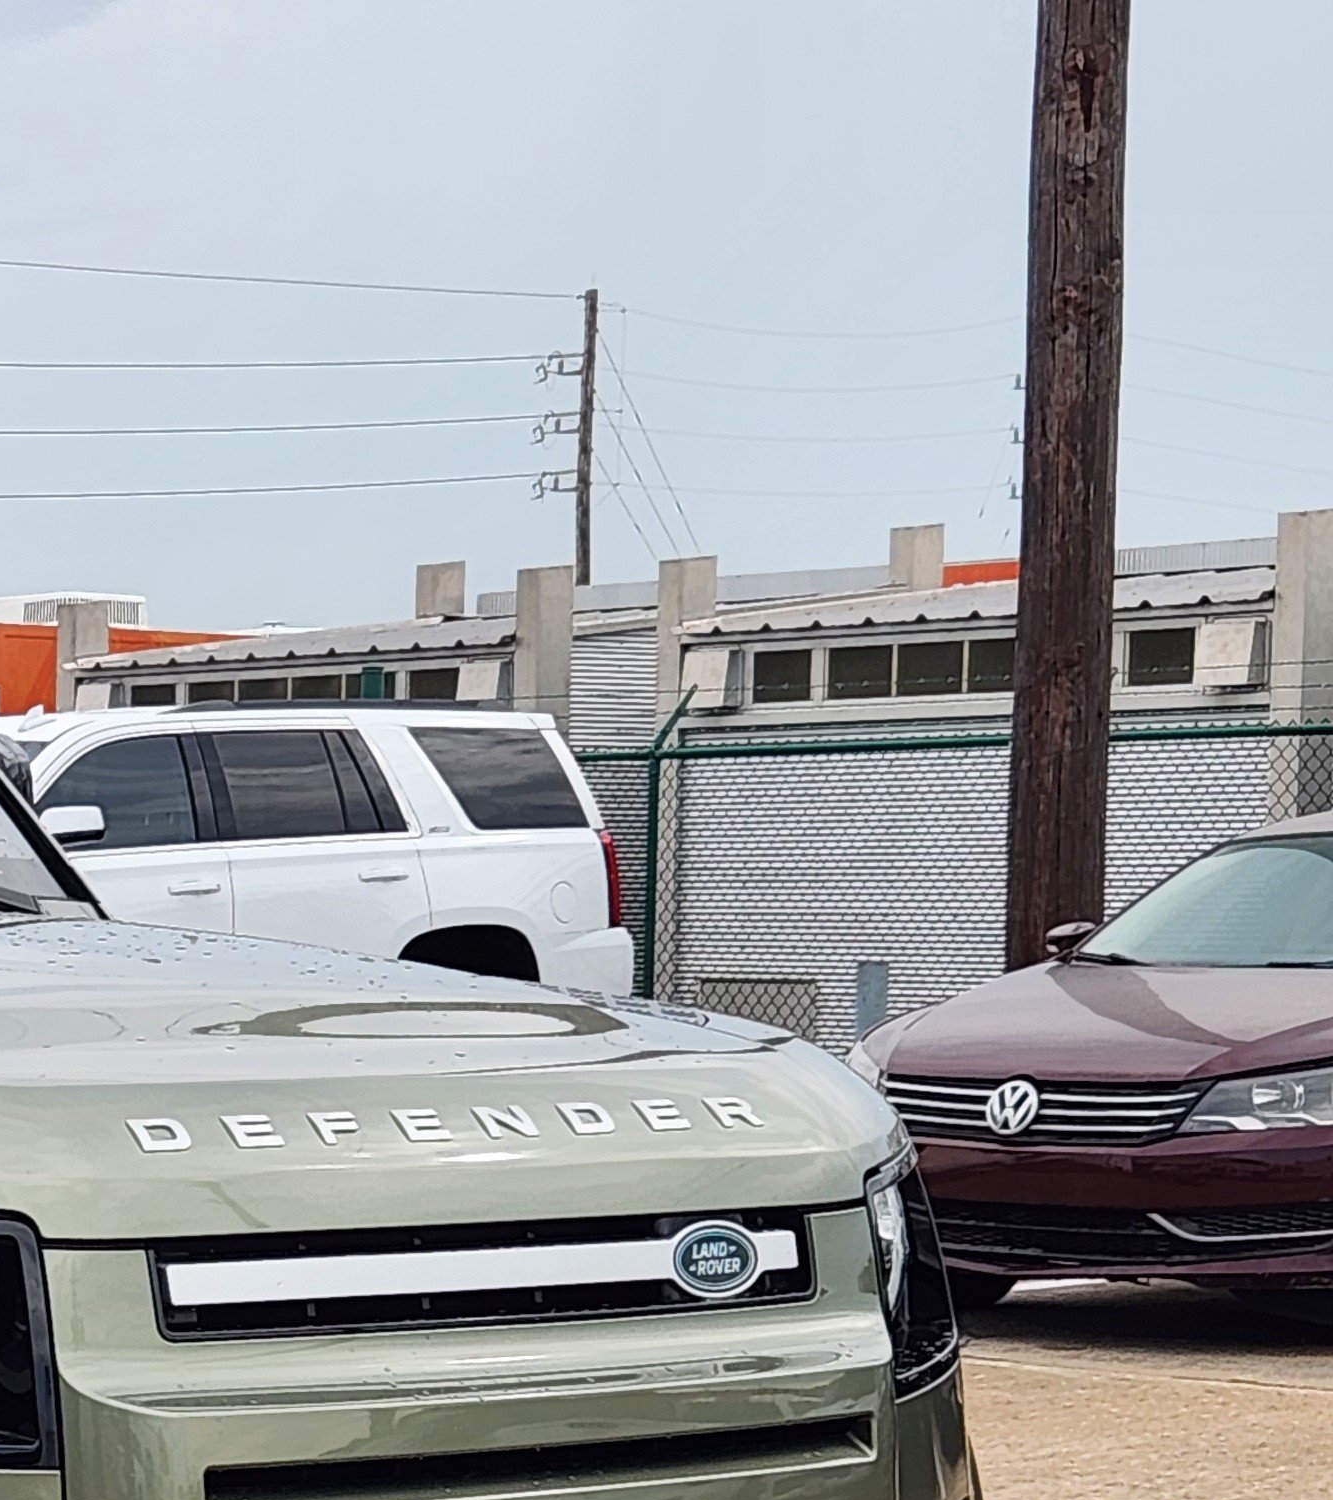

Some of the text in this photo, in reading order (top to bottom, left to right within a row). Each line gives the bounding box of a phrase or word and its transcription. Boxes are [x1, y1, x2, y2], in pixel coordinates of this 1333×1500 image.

[125, 1096, 765, 1154] DEFENDER
[691, 1241, 728, 1260] LAND
[696, 1257, 741, 1277] ROVER
